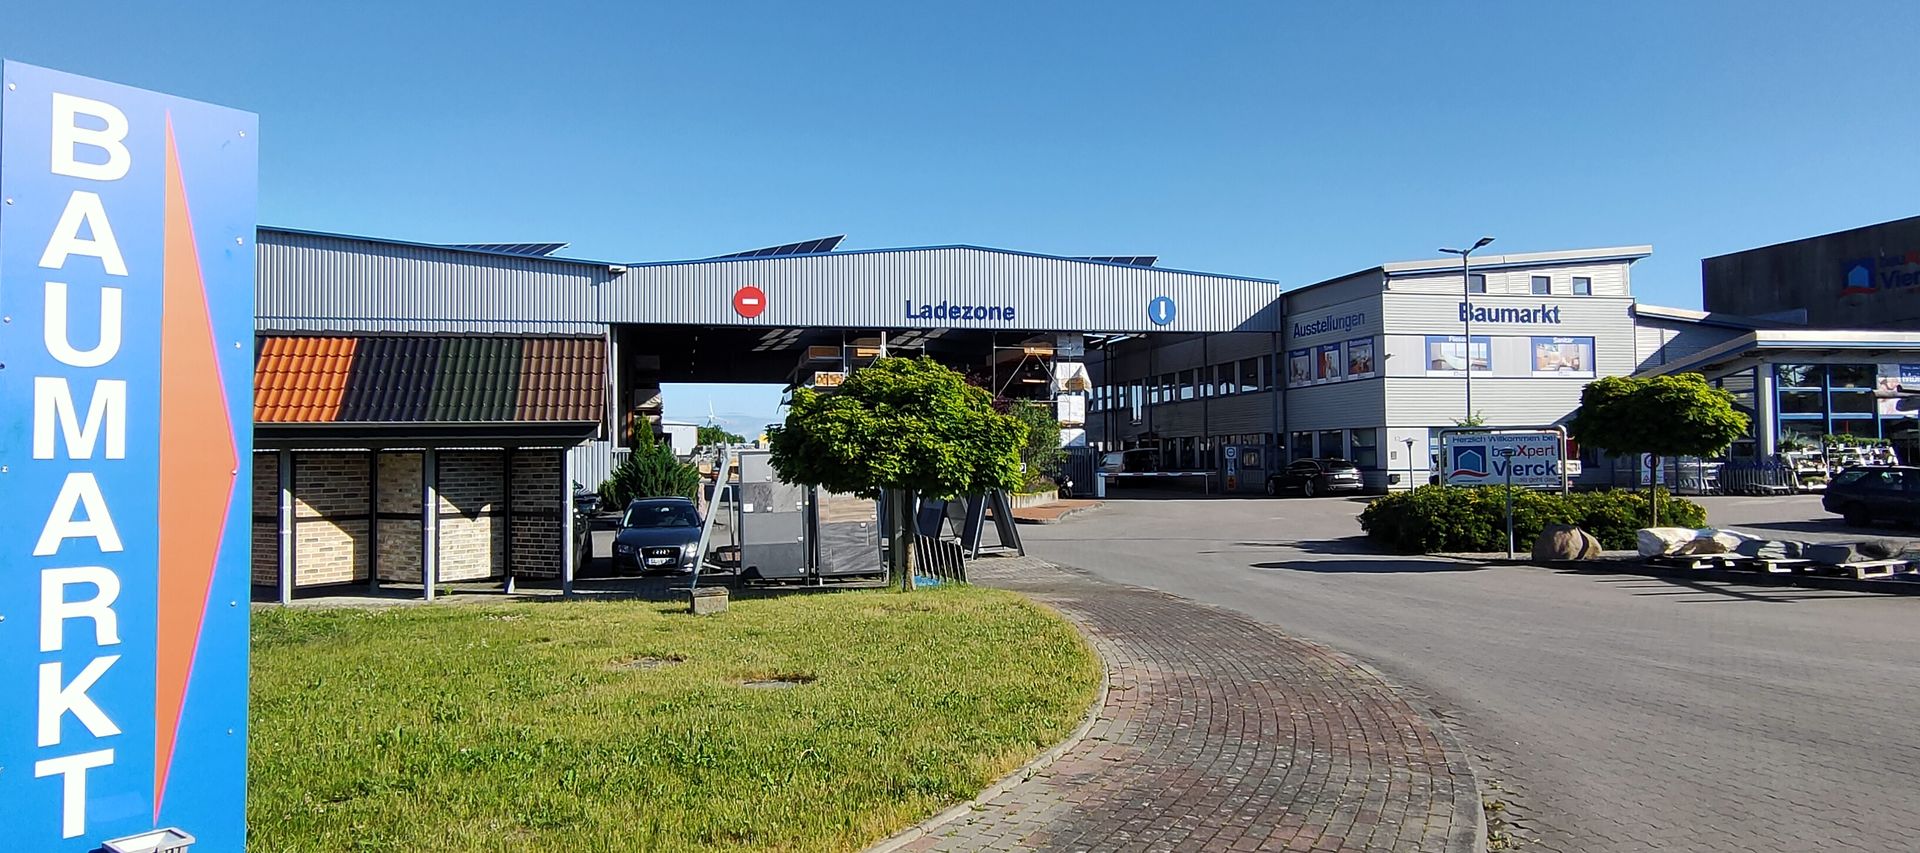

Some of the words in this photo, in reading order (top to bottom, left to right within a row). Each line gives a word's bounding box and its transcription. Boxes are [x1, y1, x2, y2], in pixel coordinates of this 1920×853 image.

[905, 299, 1015, 322] Ladezone
[1459, 302, 1561, 325] Baumarkt
[1293, 311, 1365, 339] Ausstellungen
[1452, 435, 1486, 443] Herzlich
[1488, 435, 1540, 443] Willkommen
[1542, 434, 1556, 442] bei
[32, 92, 132, 840] BAUMARKT
